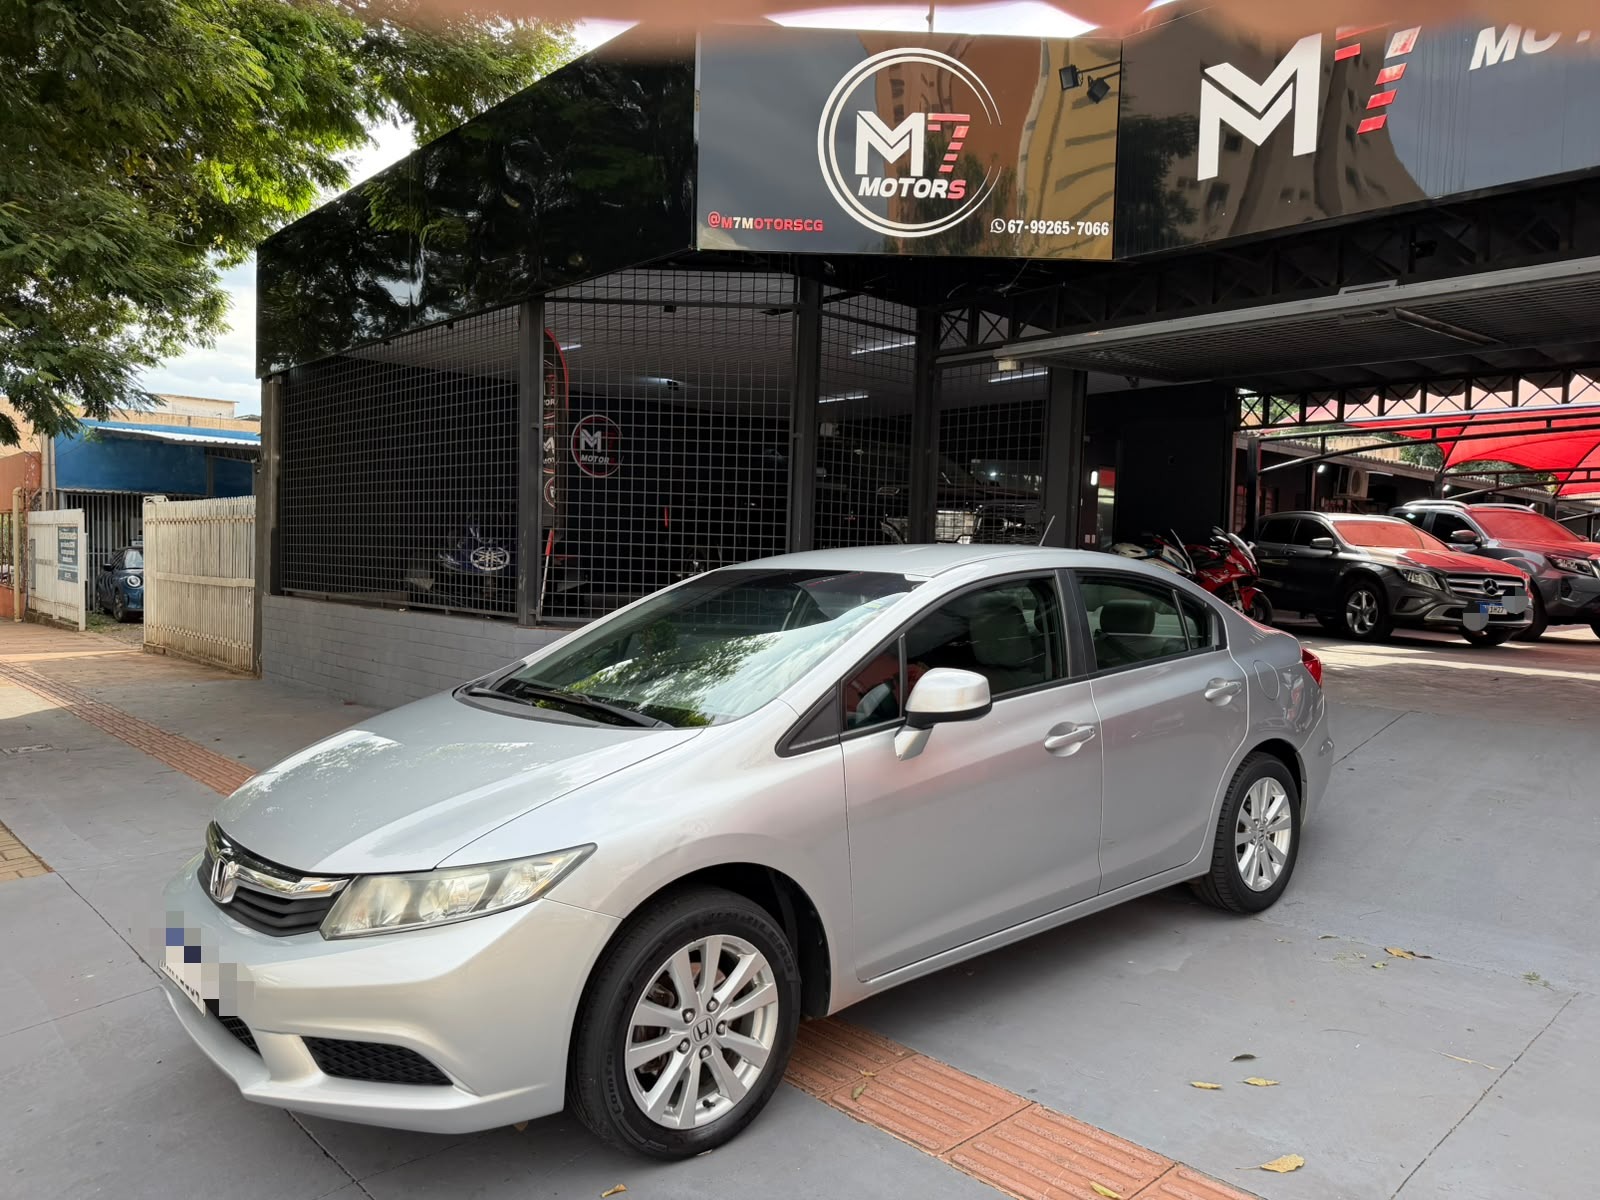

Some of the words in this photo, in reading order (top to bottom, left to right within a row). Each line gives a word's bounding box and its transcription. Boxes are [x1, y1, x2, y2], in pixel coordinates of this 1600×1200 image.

[854, 110, 971, 177] M7
[858, 176, 966, 200] MOTORS
[707, 211, 824, 231] @M7MOTORSCG
[1007, 220, 1110, 236] 67-99265-7066
